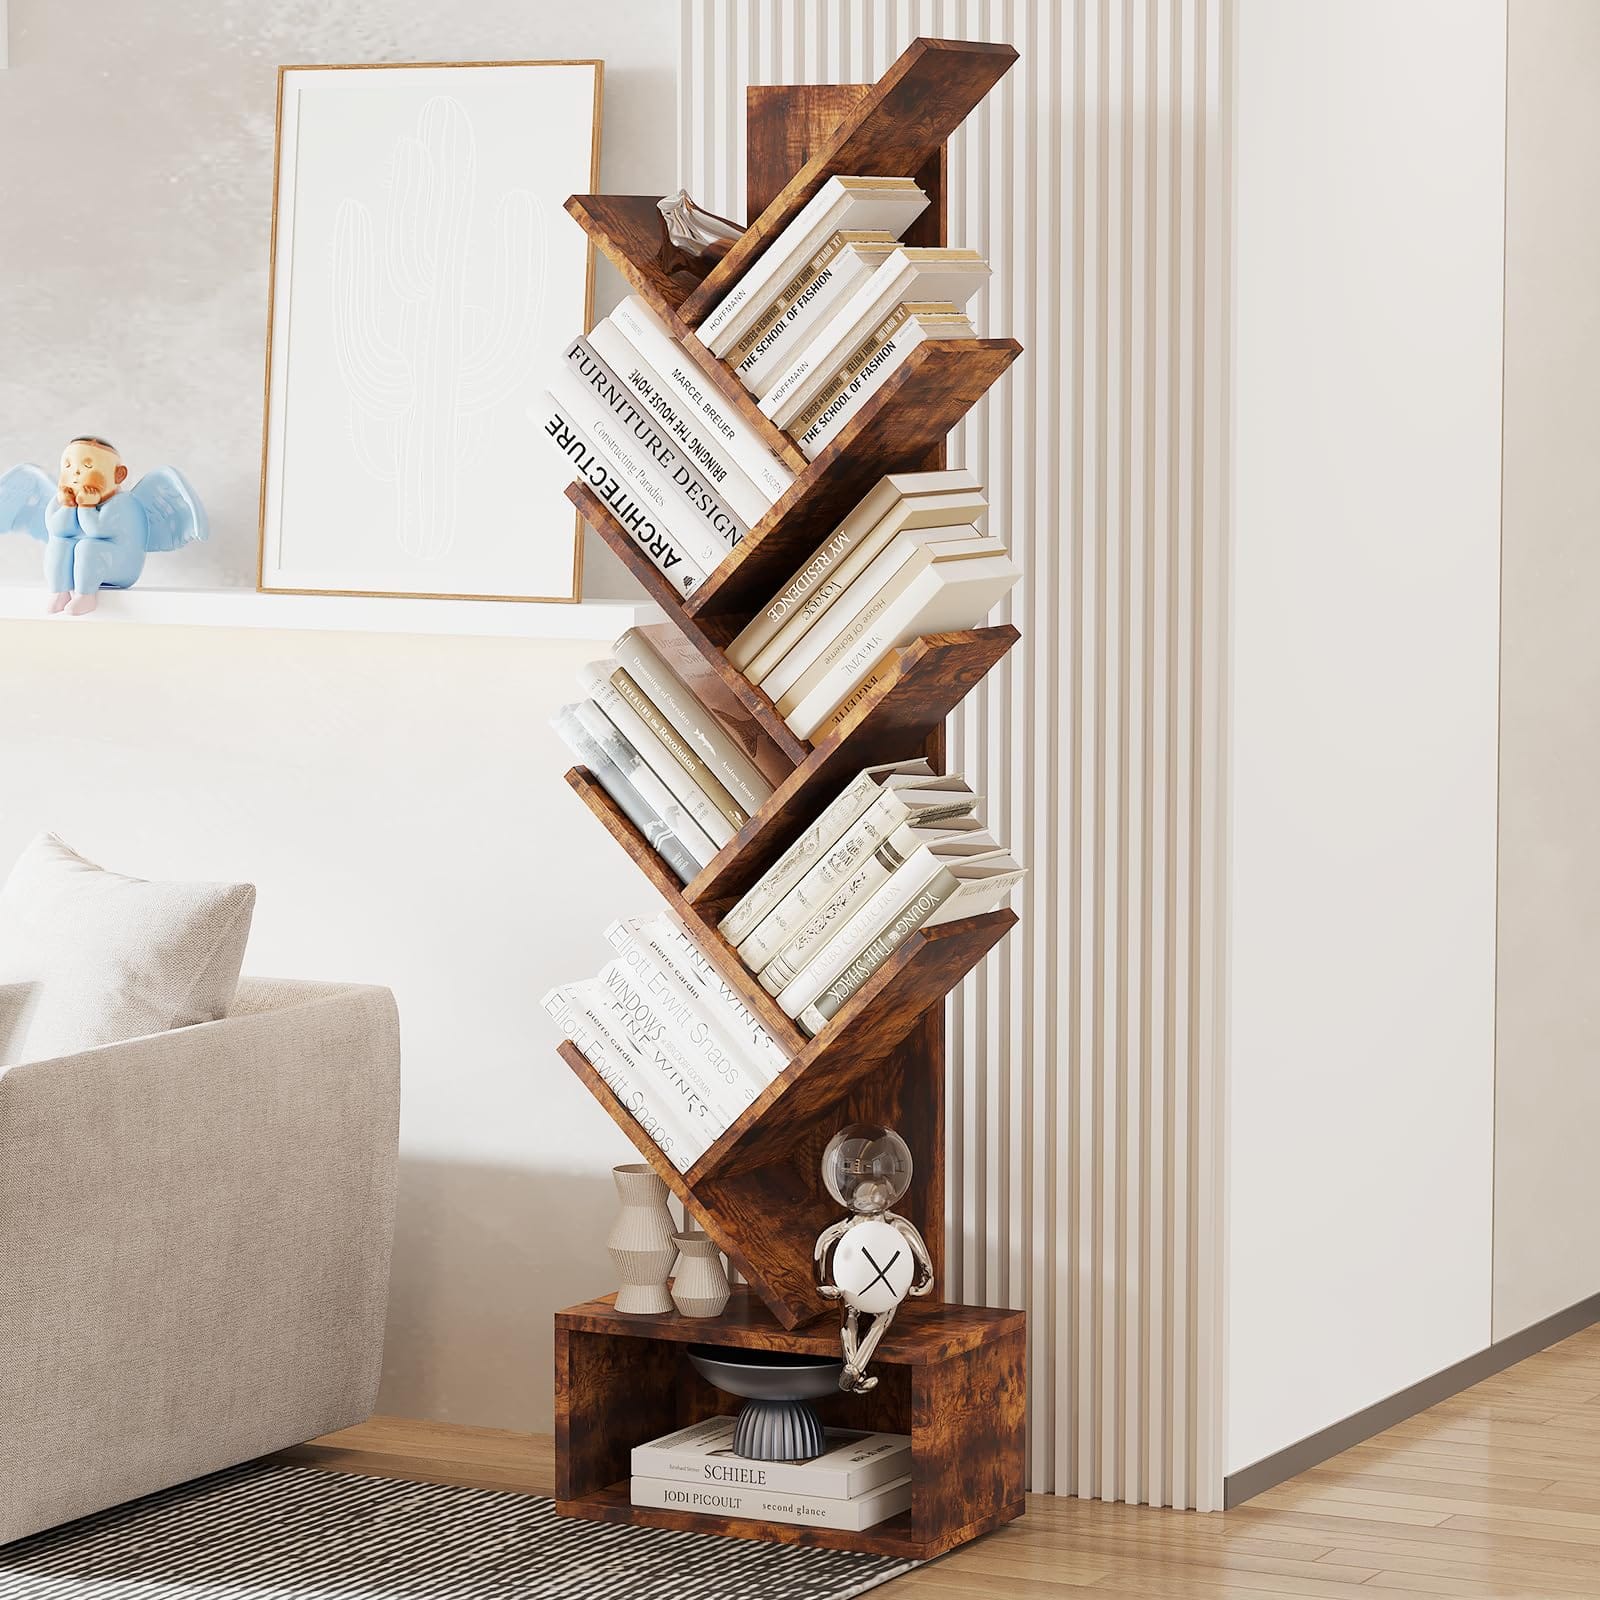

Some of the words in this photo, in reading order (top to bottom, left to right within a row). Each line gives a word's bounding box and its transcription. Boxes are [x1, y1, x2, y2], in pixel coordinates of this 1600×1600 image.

[709, 290, 747, 331] HOFFMANN
[739, 353, 759, 373] THE
[755, 320, 789, 357] SCHOOL
[786, 305, 800, 322] OF
[798, 268, 833, 310] FASHION
[627, 368, 655, 397] HOME
[671, 368, 703, 405] MARCEL
[702, 404, 736, 440] BREUER
[771, 360, 809, 403] HOFFMANN
[801, 424, 821, 445] THE
[818, 391, 853, 429] SCHOOL
[850, 376, 863, 393] OF
[860, 339, 897, 381] FASHION
[651, 392, 679, 427] HOUSE
[672, 422, 692, 444] THE
[568, 344, 675, 469] FURNITURE
[672, 464, 745, 548] DESIGN
[593, 420, 637, 476] Constructing
[688, 437, 728, 484] BRINGING
[545, 412, 682, 570] ARCHITECTURE
[830, 530, 851, 557] MY
[767, 553, 833, 623] RESIDENCE
[802, 581, 843, 622] Voyage
[862, 598, 887, 624] House
[824, 635, 854, 665] Boheme
[850, 623, 865, 638] Of
[632, 656, 661, 693] Dreaming
[660, 689, 670, 702] of
[667, 695, 691, 727] Sweden
[832, 675, 881, 726] BAGUETTE
[617, 679, 653, 722] REVEALING
[659, 725, 697, 773] Revolution
[899, 890, 941, 940] YOUNG
[650, 941, 674, 970] pierre
[674, 968, 700, 1000] cardin
[866, 936, 895, 965] THE
[606, 968, 667, 1042] WINDOWS
[608, 924, 651, 978] Elliott
[647, 971, 692, 1028] Erwitt
[690, 1022, 740, 1085] Snaps
[826, 959, 873, 1005] SHACK
[586, 1009, 610, 1037] pierre
[610, 1037, 636, 1068] cardin
[544, 993, 588, 1047] Elliott
[583, 1040, 629, 1097] Erwitt
[625, 1090, 675, 1153] Snaps
[704, 1464, 767, 1486] SCHIELE
[663, 1490, 690, 1504] JODI
[692, 1493, 743, 1509] PICOULT
[762, 1502, 794, 1514] second
[796, 1505, 827, 1518] glance
